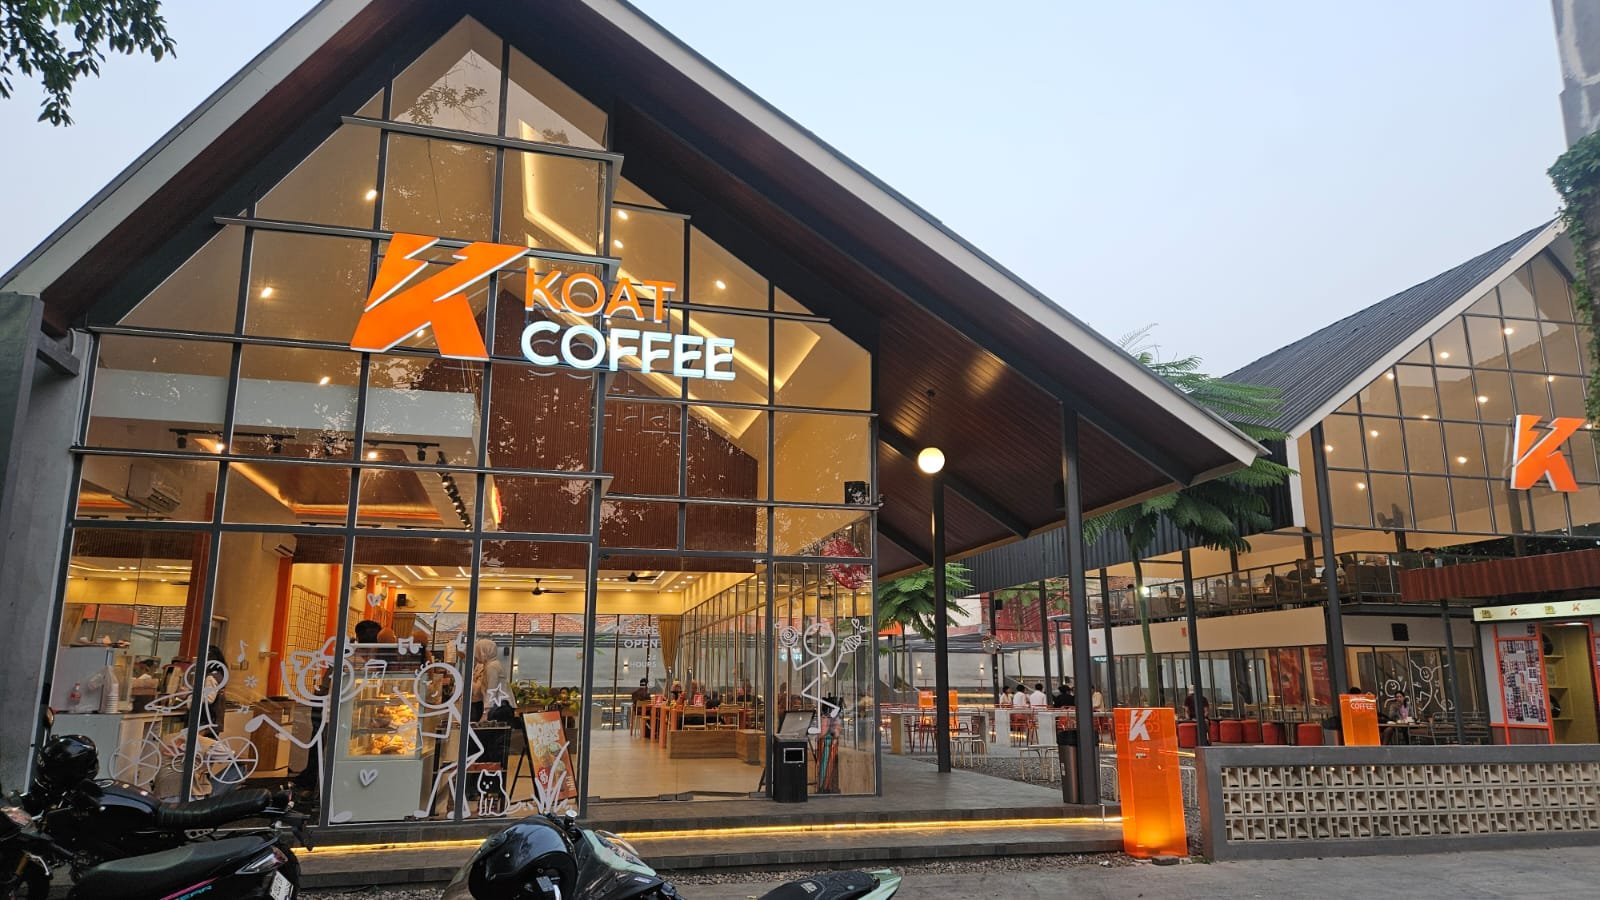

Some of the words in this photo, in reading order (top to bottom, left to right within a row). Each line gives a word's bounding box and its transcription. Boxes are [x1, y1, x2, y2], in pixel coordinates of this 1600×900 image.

[350, 232, 531, 361] K
[525, 267, 676, 323] KOAT
[521, 320, 736, 381] COFFEE
[1510, 414, 1586, 493] K
[624, 639, 658, 648] OPEN
[1350, 702, 1376, 710] COFFEE
